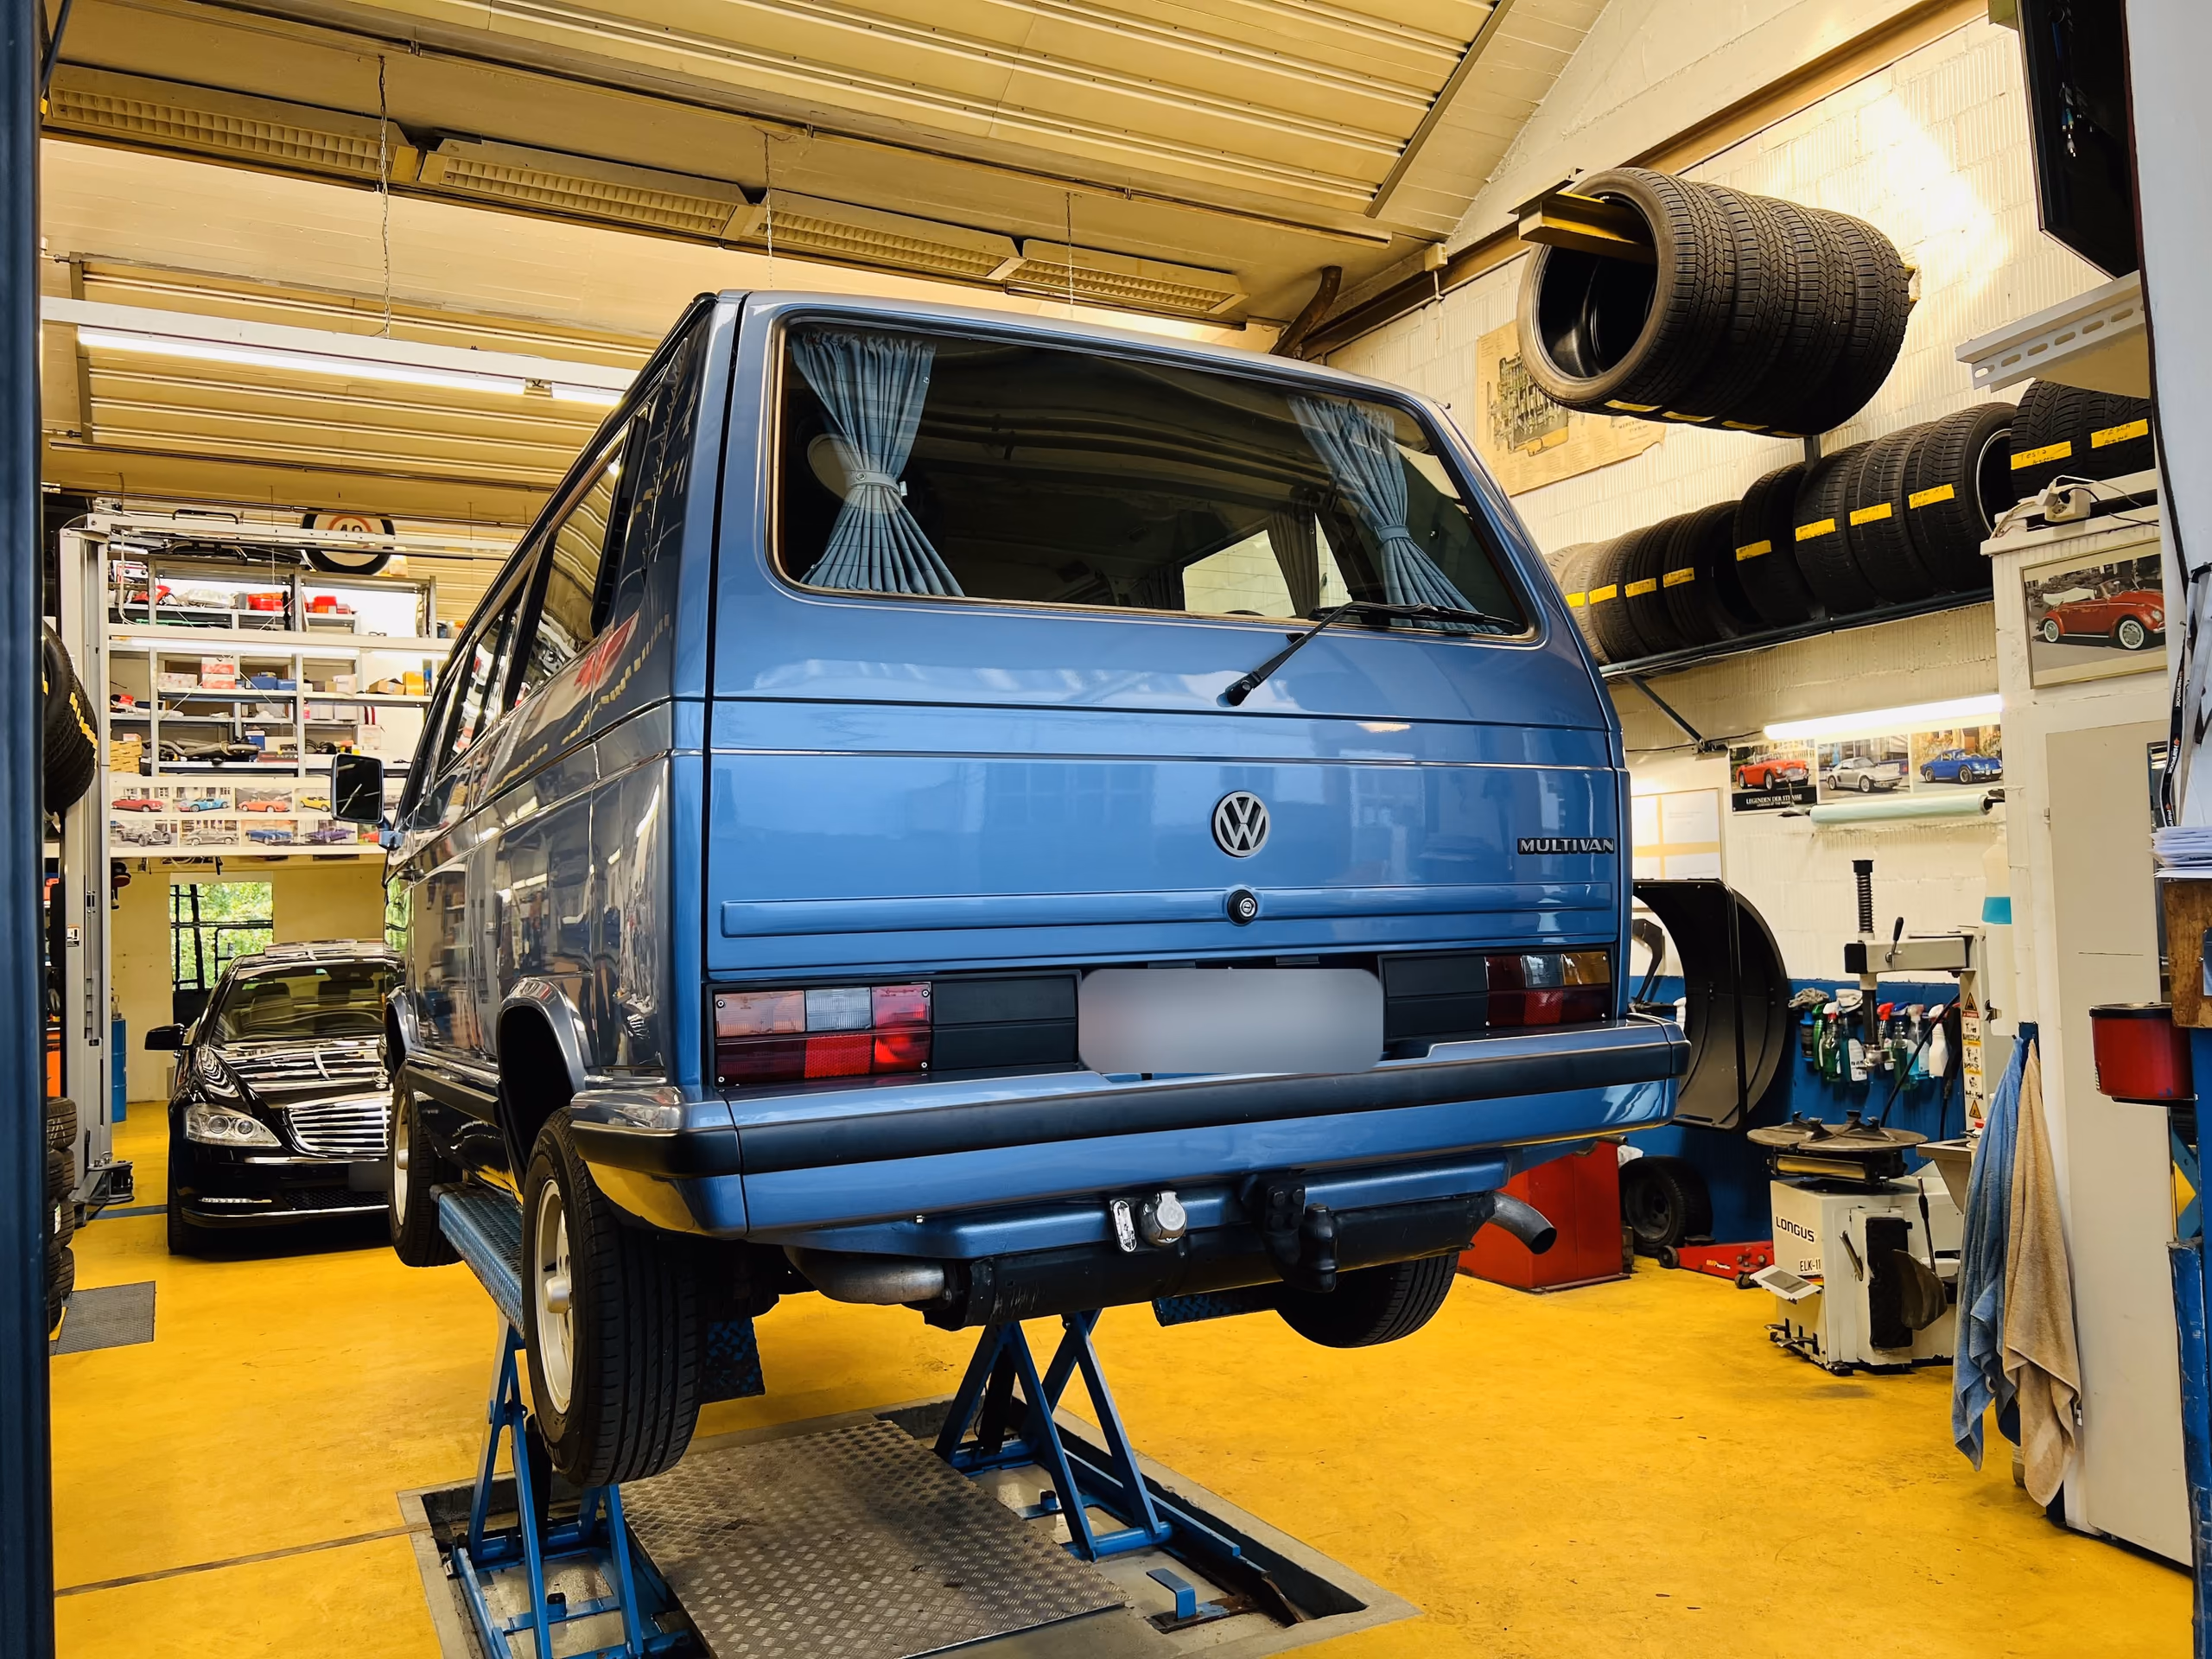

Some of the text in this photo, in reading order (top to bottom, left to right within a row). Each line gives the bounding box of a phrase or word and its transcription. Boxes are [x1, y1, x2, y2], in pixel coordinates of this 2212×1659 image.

[1518, 838, 1614, 854] MULTIVAN
[1776, 1216, 1815, 1243] LONGUS
[1800, 1259, 1821, 1272] ELK-11
